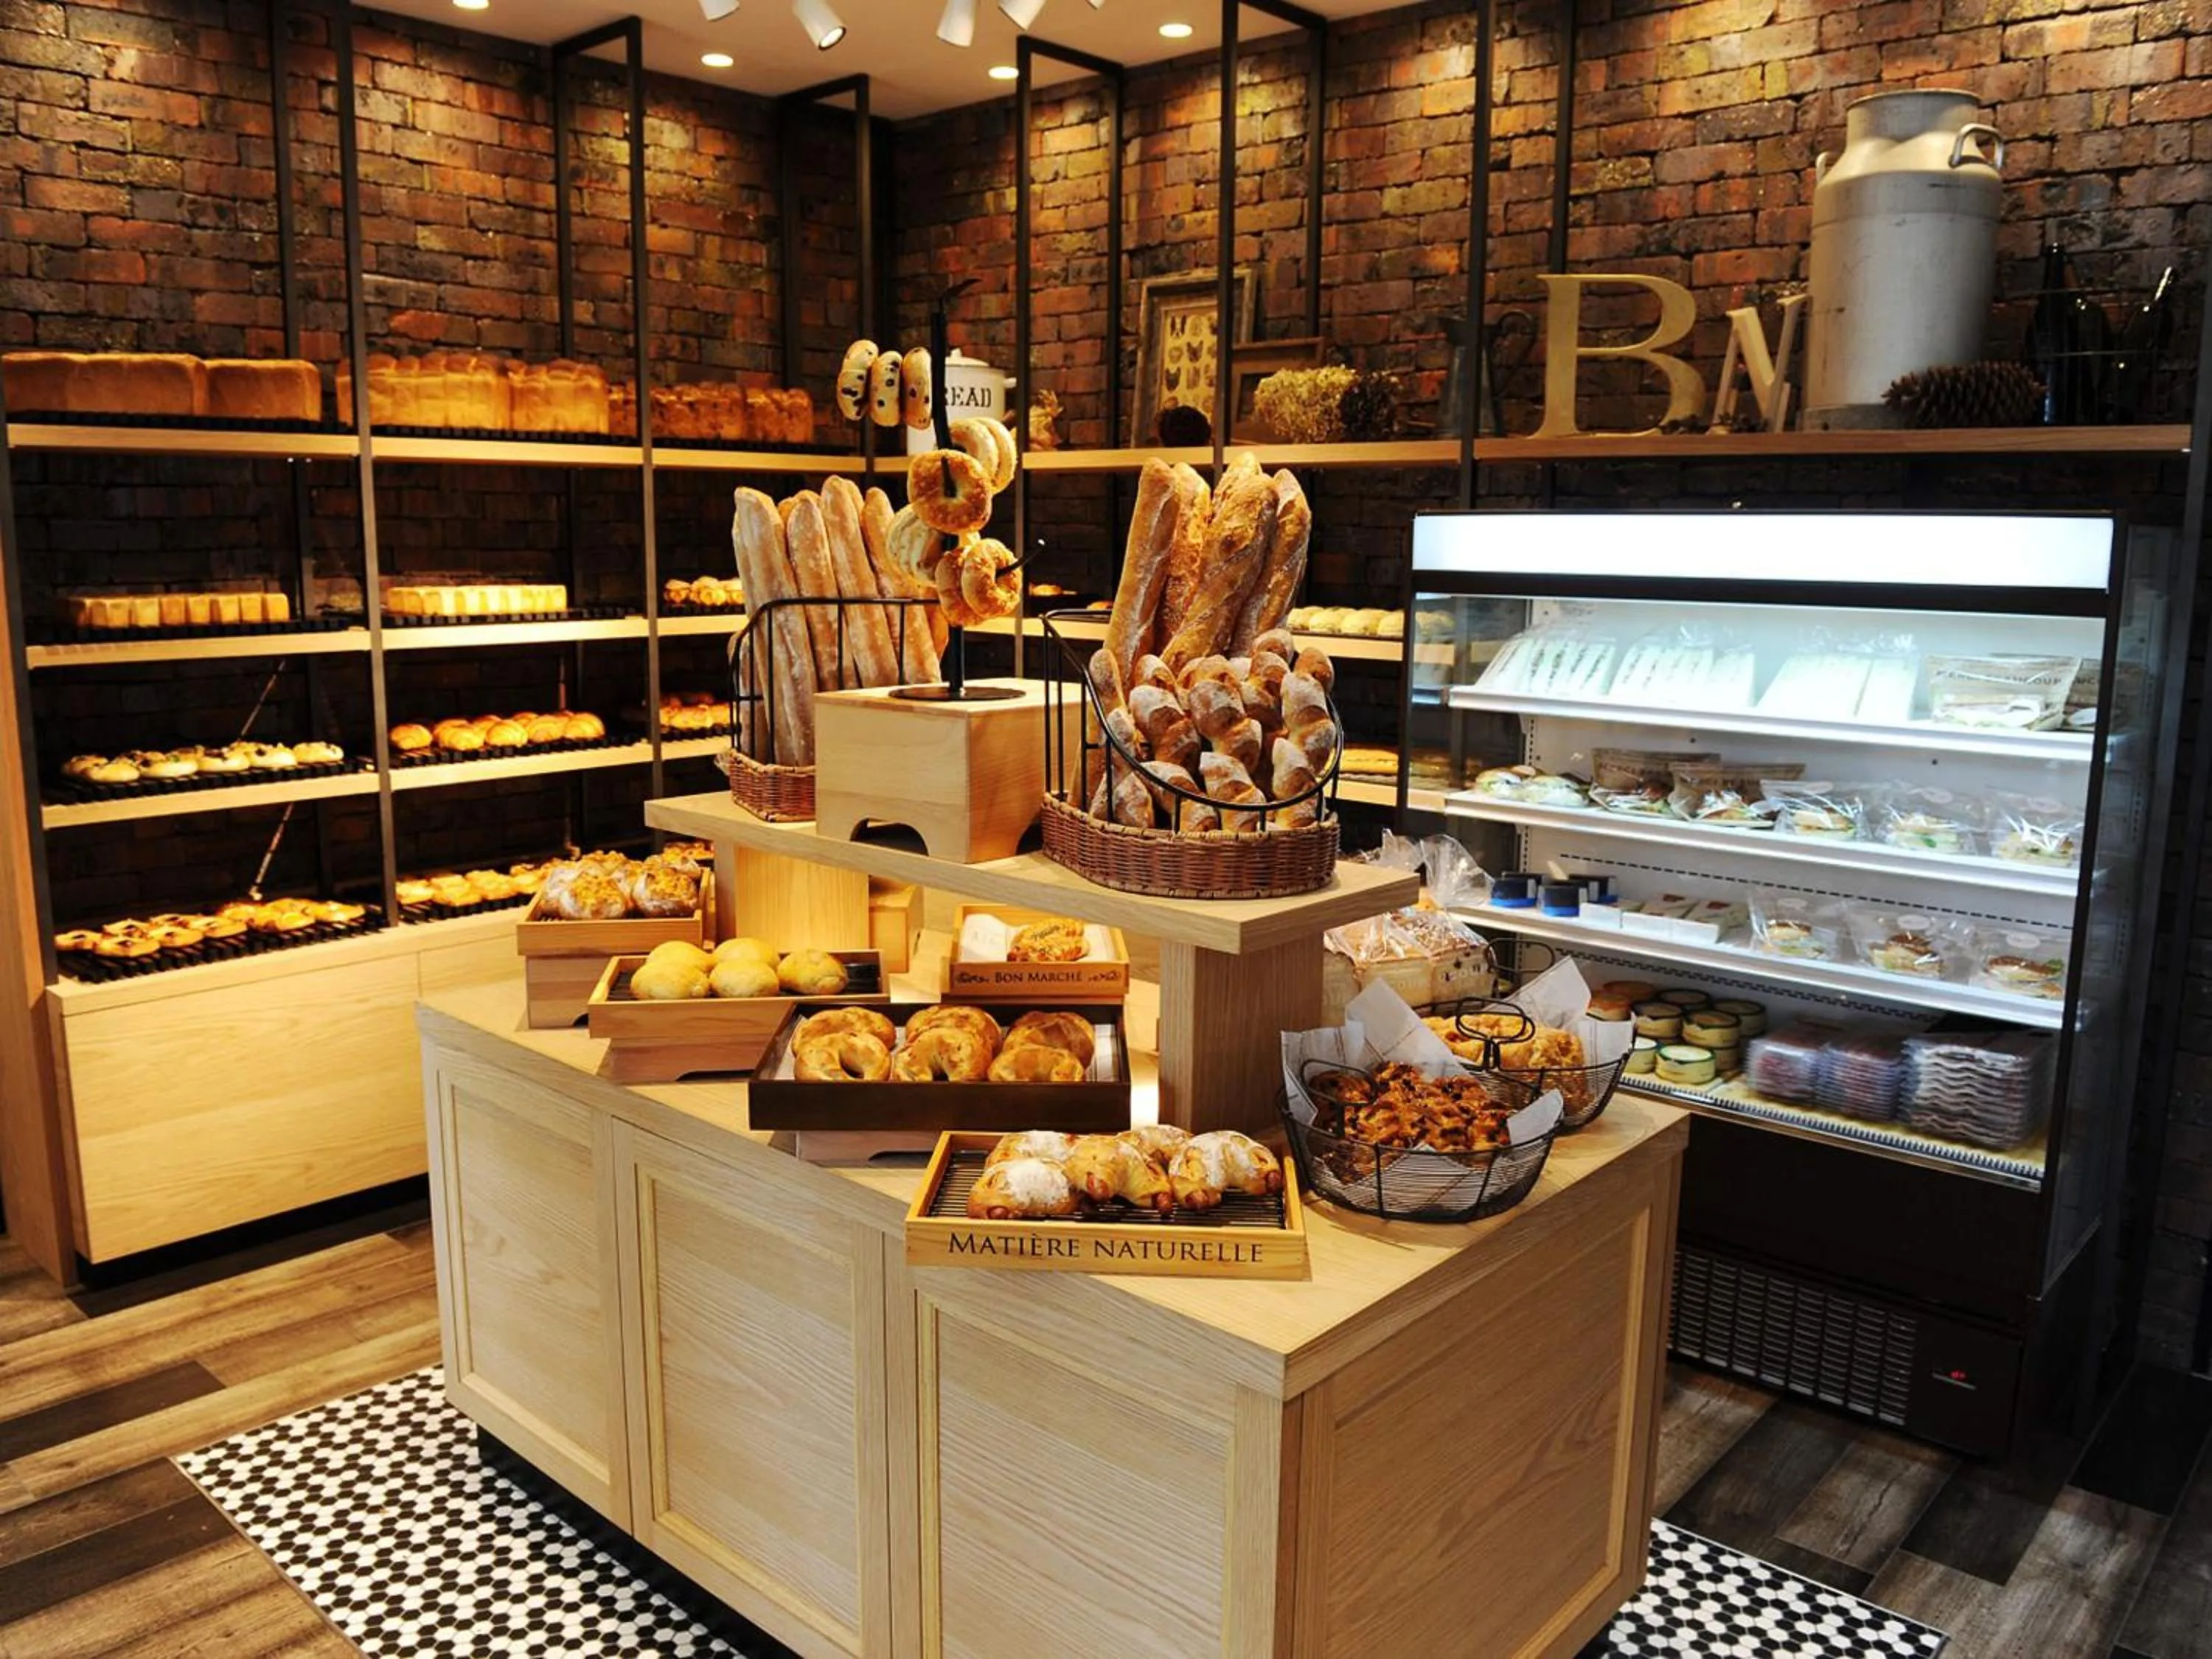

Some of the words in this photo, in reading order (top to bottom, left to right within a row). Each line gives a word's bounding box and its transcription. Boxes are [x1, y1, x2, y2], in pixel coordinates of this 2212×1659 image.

[1526, 274, 1706, 439] B
[945, 387, 992, 408] EAD
[995, 971, 1023, 984] BON
[948, 1232, 1080, 1258] MATIÈRE
[1094, 1239, 1264, 1263] NATURELLE
